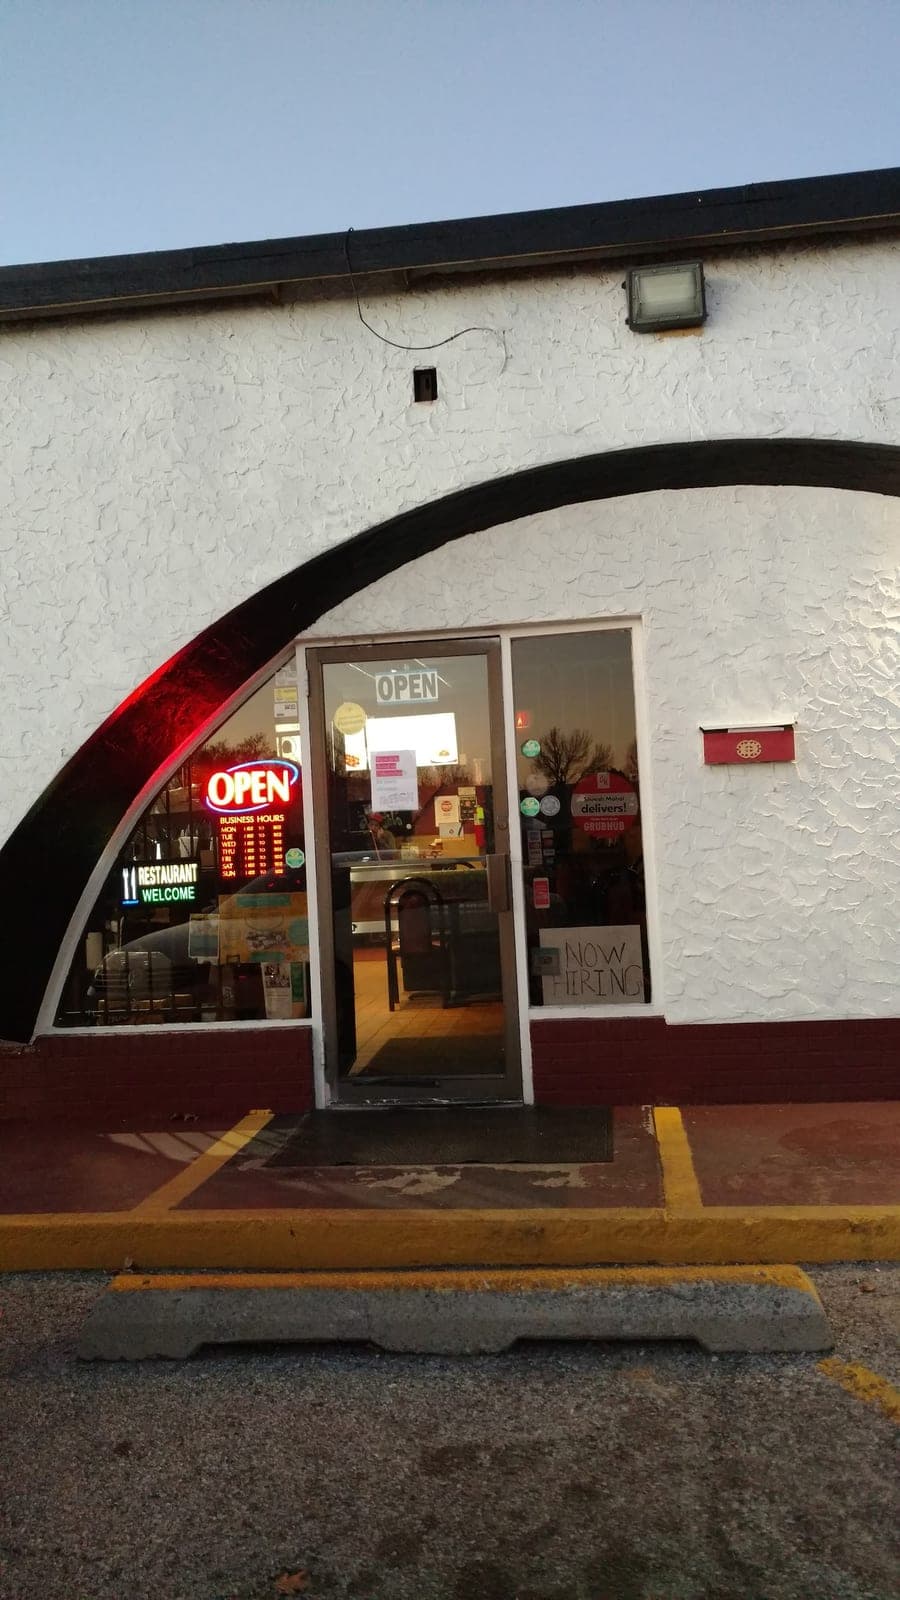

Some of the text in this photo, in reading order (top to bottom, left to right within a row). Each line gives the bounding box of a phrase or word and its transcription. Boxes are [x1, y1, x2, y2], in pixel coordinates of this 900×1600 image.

[377, 672, 437, 701] OPEN
[207, 770, 290, 806] OPEN
[220, 814, 285, 825] BUSINESS HOURS
[581, 803, 626, 814] delivers!
[583, 821, 625, 832] GRUBHUB
[138, 863, 198, 886] RESTAURANT
[142, 886, 196, 903] WELCOME
[565, 941, 627, 968] NOW
[552, 964, 642, 996] HIRING
